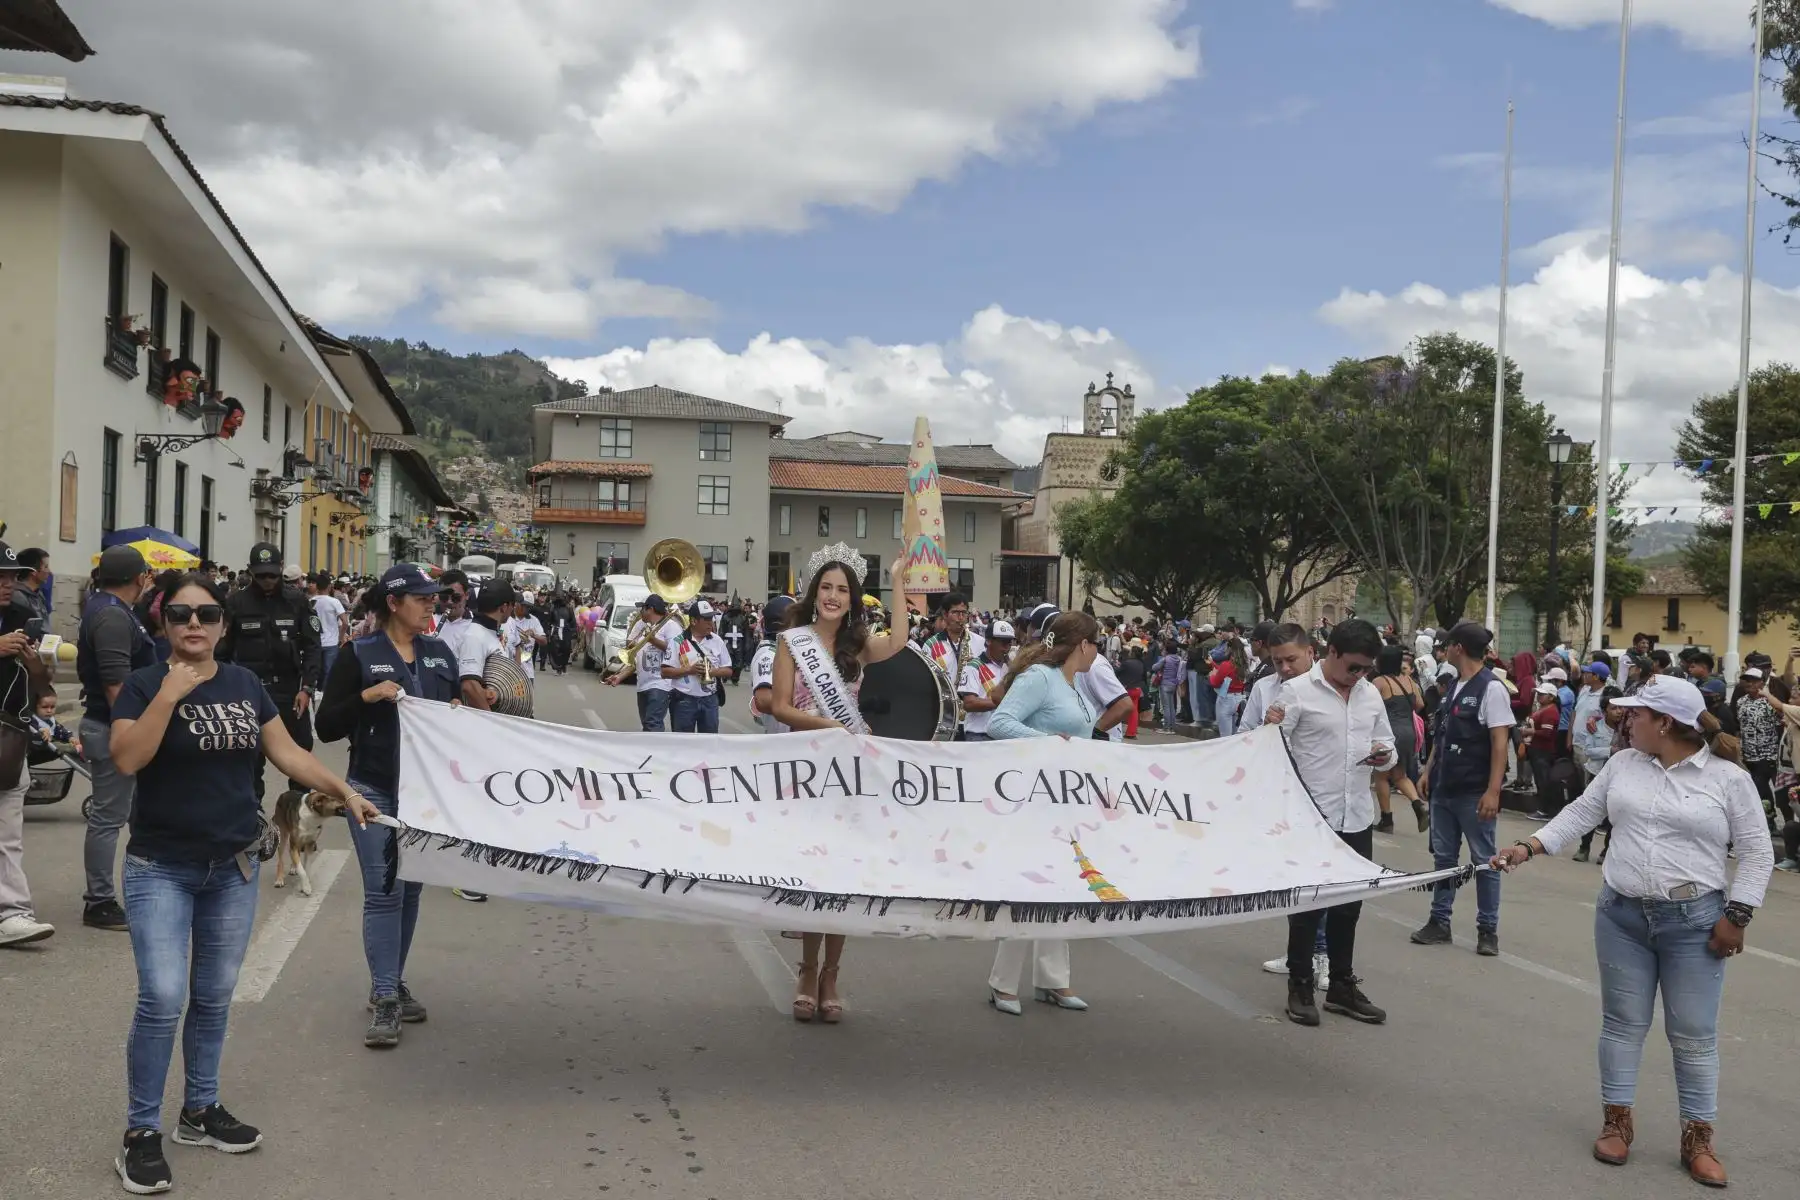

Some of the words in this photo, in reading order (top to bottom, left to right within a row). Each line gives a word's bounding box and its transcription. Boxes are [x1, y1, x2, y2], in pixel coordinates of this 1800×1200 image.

[179, 700, 256, 720] GUESS
[189, 718, 260, 734] GUESS
[199, 734, 257, 750] GUESS
[484, 755, 660, 806] COMITÉ
[670, 756, 878, 804] CENTRAL
[892, 759, 982, 806] DEL
[994, 769, 1210, 824] CARNAVAL
